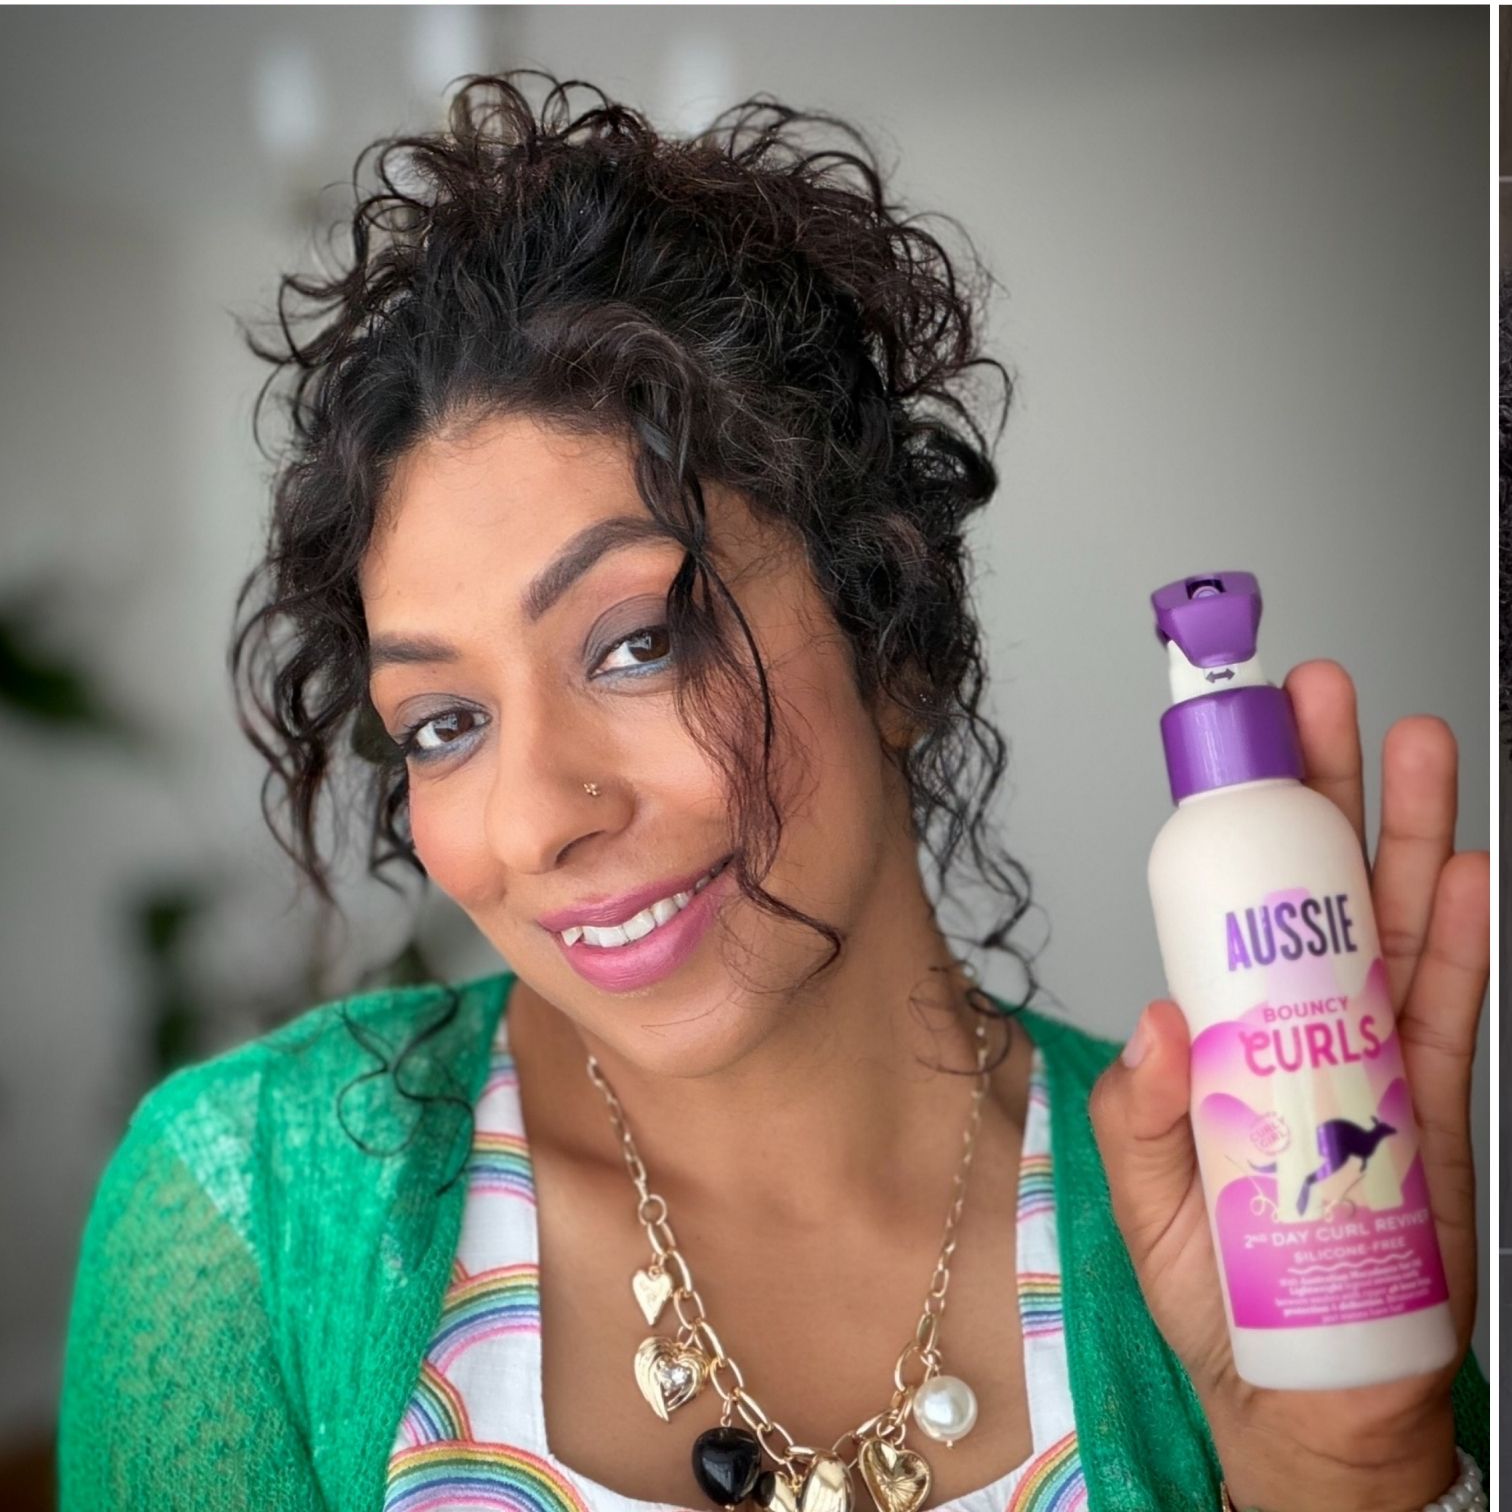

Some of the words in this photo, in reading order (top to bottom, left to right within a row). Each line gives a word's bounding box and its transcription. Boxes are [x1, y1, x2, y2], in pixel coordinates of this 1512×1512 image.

[1225, 894, 1357, 972] AUSSIE
[1263, 996, 1349, 1024] BOUNCY
[1238, 1015, 1382, 1077] CURLS
[1272, 1230, 1308, 1247] DAY
[1316, 1224, 1370, 1241] CURL
[1294, 1237, 1406, 1263] SILICONE-FREE
